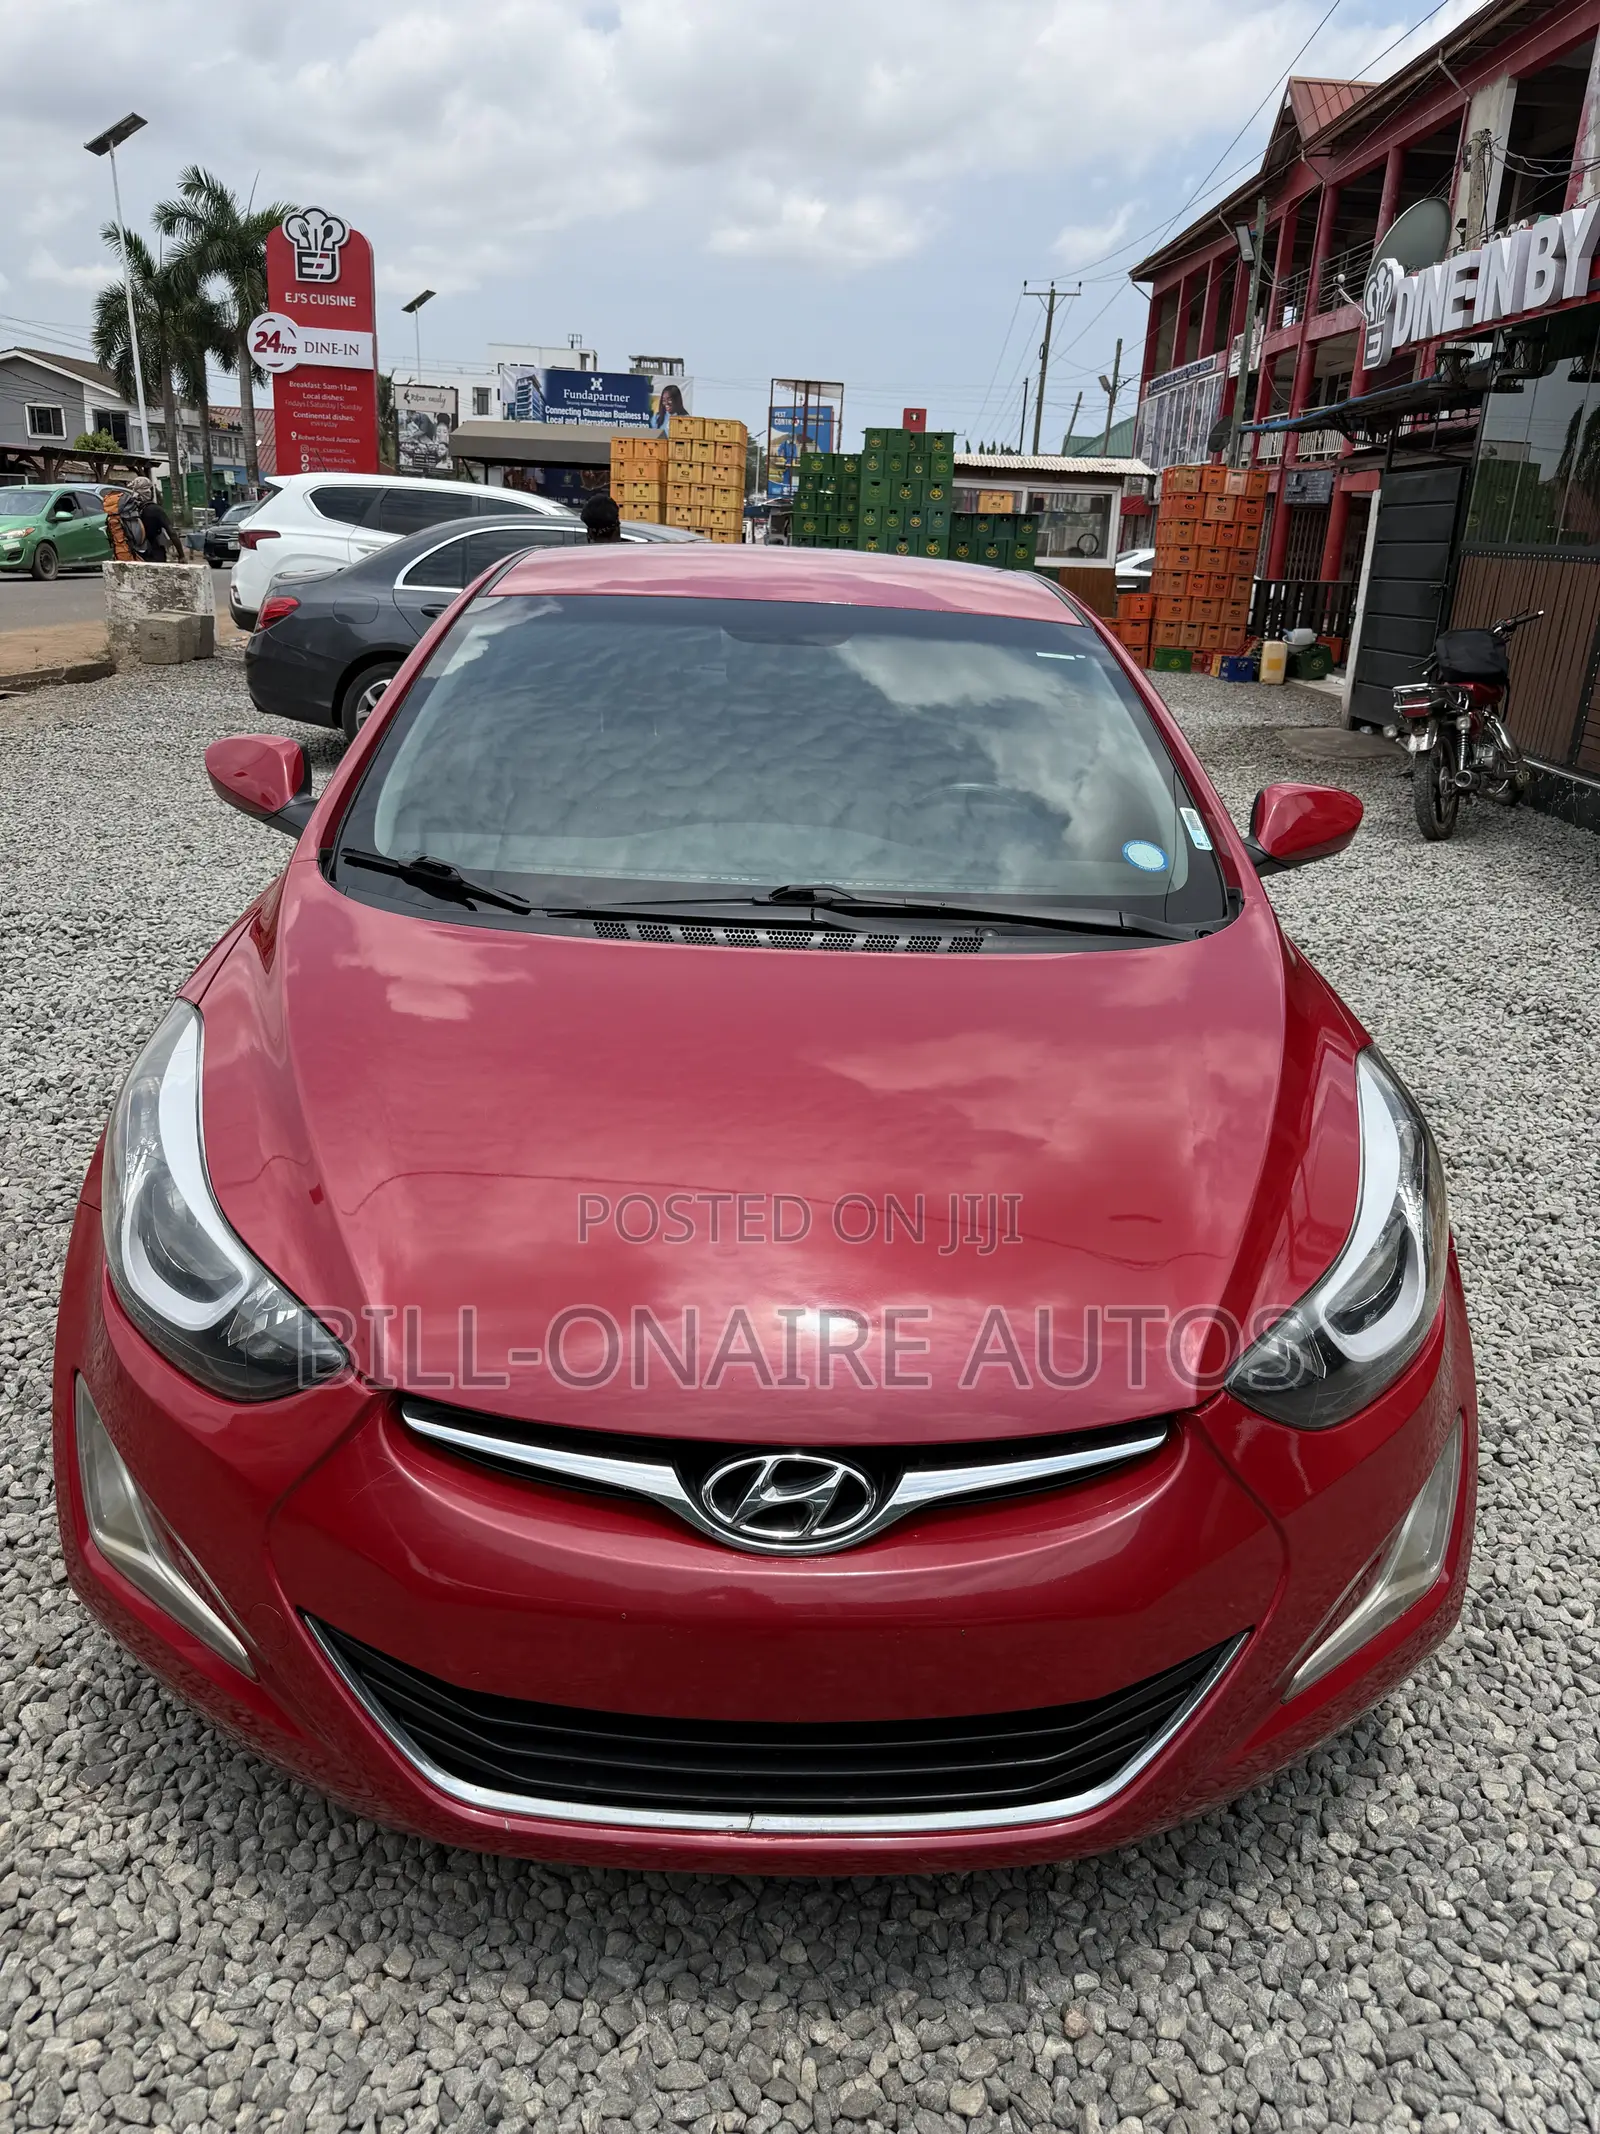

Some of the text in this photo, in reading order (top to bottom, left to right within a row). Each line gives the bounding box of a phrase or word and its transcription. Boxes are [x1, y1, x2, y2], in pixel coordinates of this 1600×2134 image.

[1522, 198, 1600, 311] BY
[285, 292, 357, 307] EJ'S CUISINE
[304, 341, 360, 356] DINE-IN
[563, 389, 631, 403] Fundapartner
[292, 411, 332, 420] Continental
[545, 405, 650, 421] Connecting Ghanaian Business to
[546, 415, 564, 424] Local
[564, 417, 578, 426] and
[578, 418, 619, 428] International
